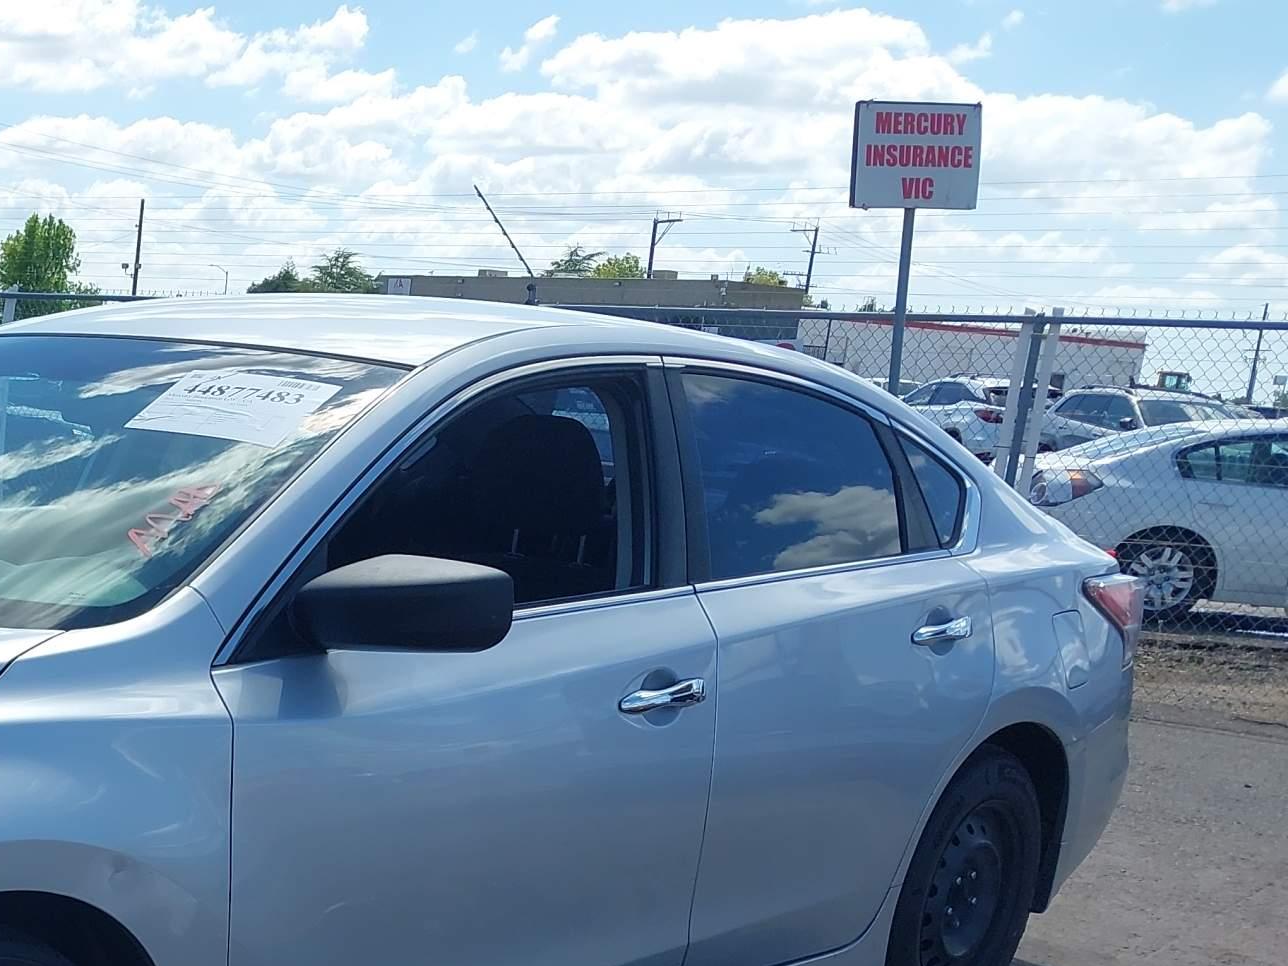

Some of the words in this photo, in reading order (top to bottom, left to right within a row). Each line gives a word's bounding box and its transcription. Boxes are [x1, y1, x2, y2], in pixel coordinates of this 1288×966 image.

[875, 111, 967, 135] MERCURY
[865, 144, 973, 168] INSURANCE
[901, 177, 934, 200] VIC
[183, 383, 304, 404] 44877483
